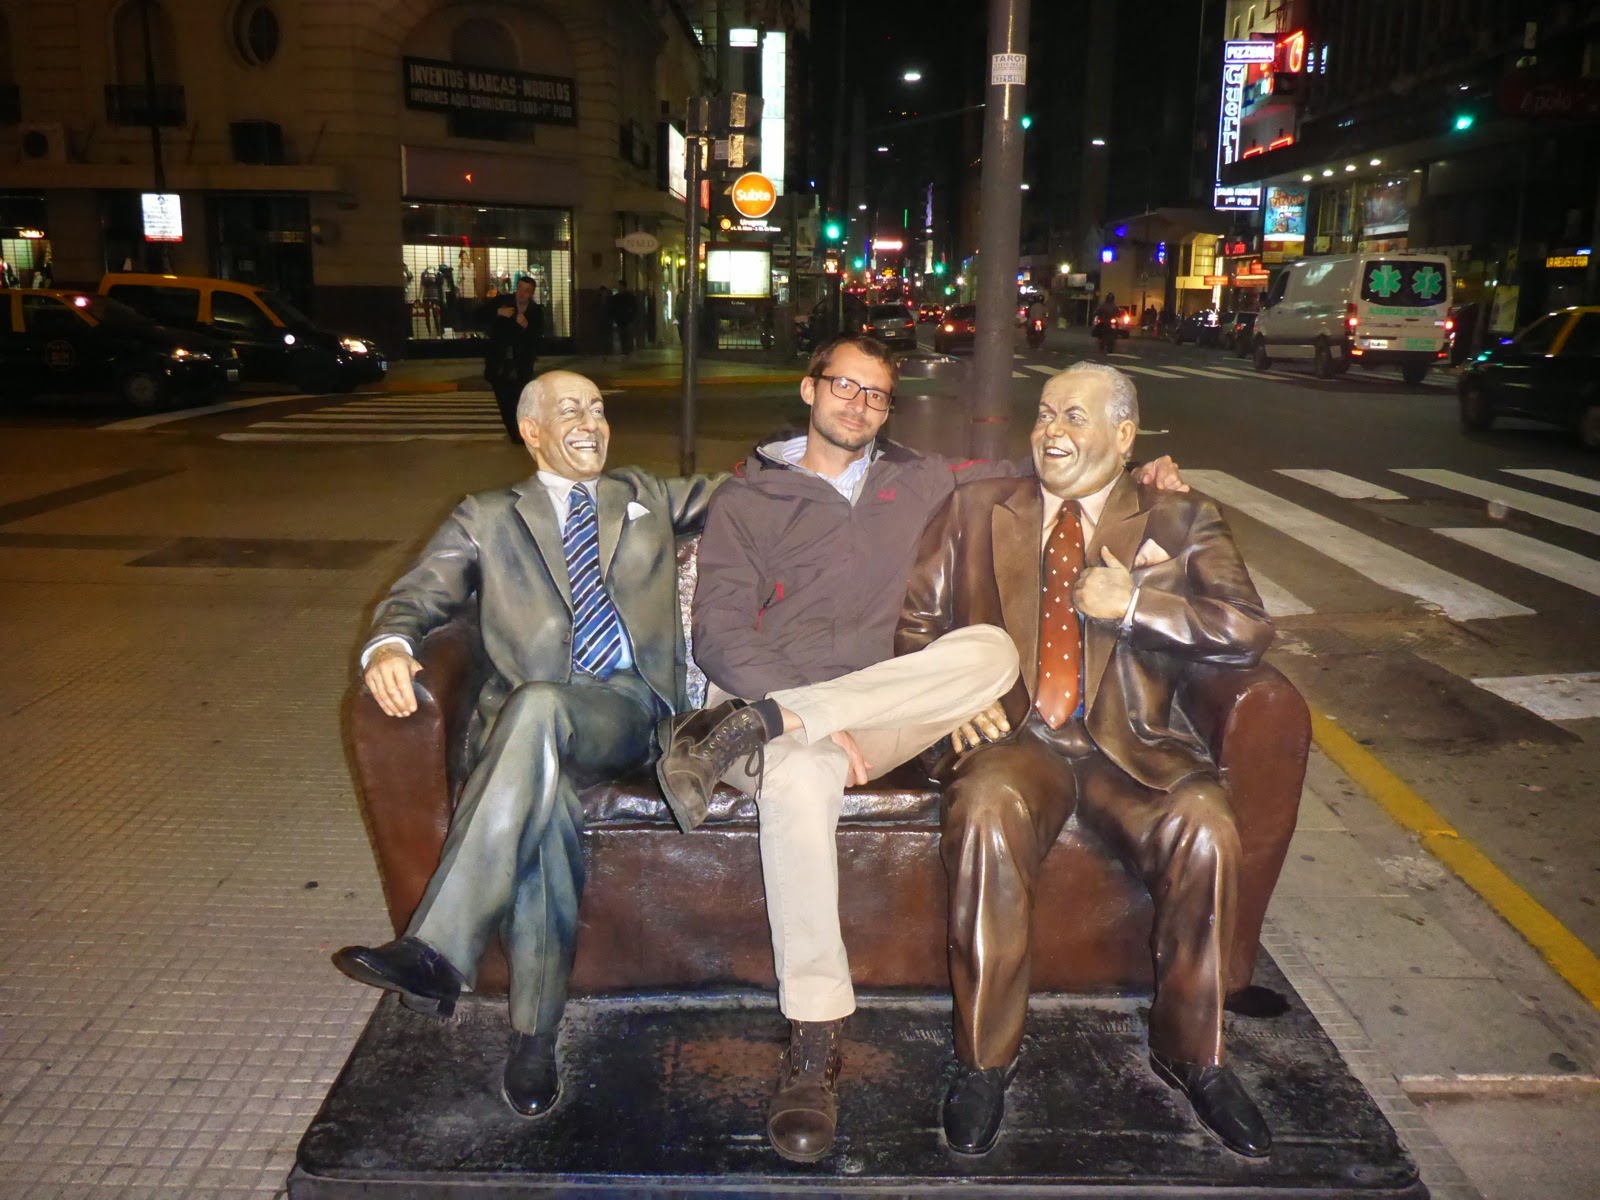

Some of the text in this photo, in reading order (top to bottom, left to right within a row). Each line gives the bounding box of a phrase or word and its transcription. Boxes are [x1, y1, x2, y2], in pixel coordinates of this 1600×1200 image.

[410, 65, 570, 102] INVENTOS MARCAS MODELOS
[1222, 64, 1241, 164] Guerri
[736, 189, 771, 202] Subte
[627, 240, 655, 248] NMD
[1368, 307, 1438, 317] AMBULANCIA
